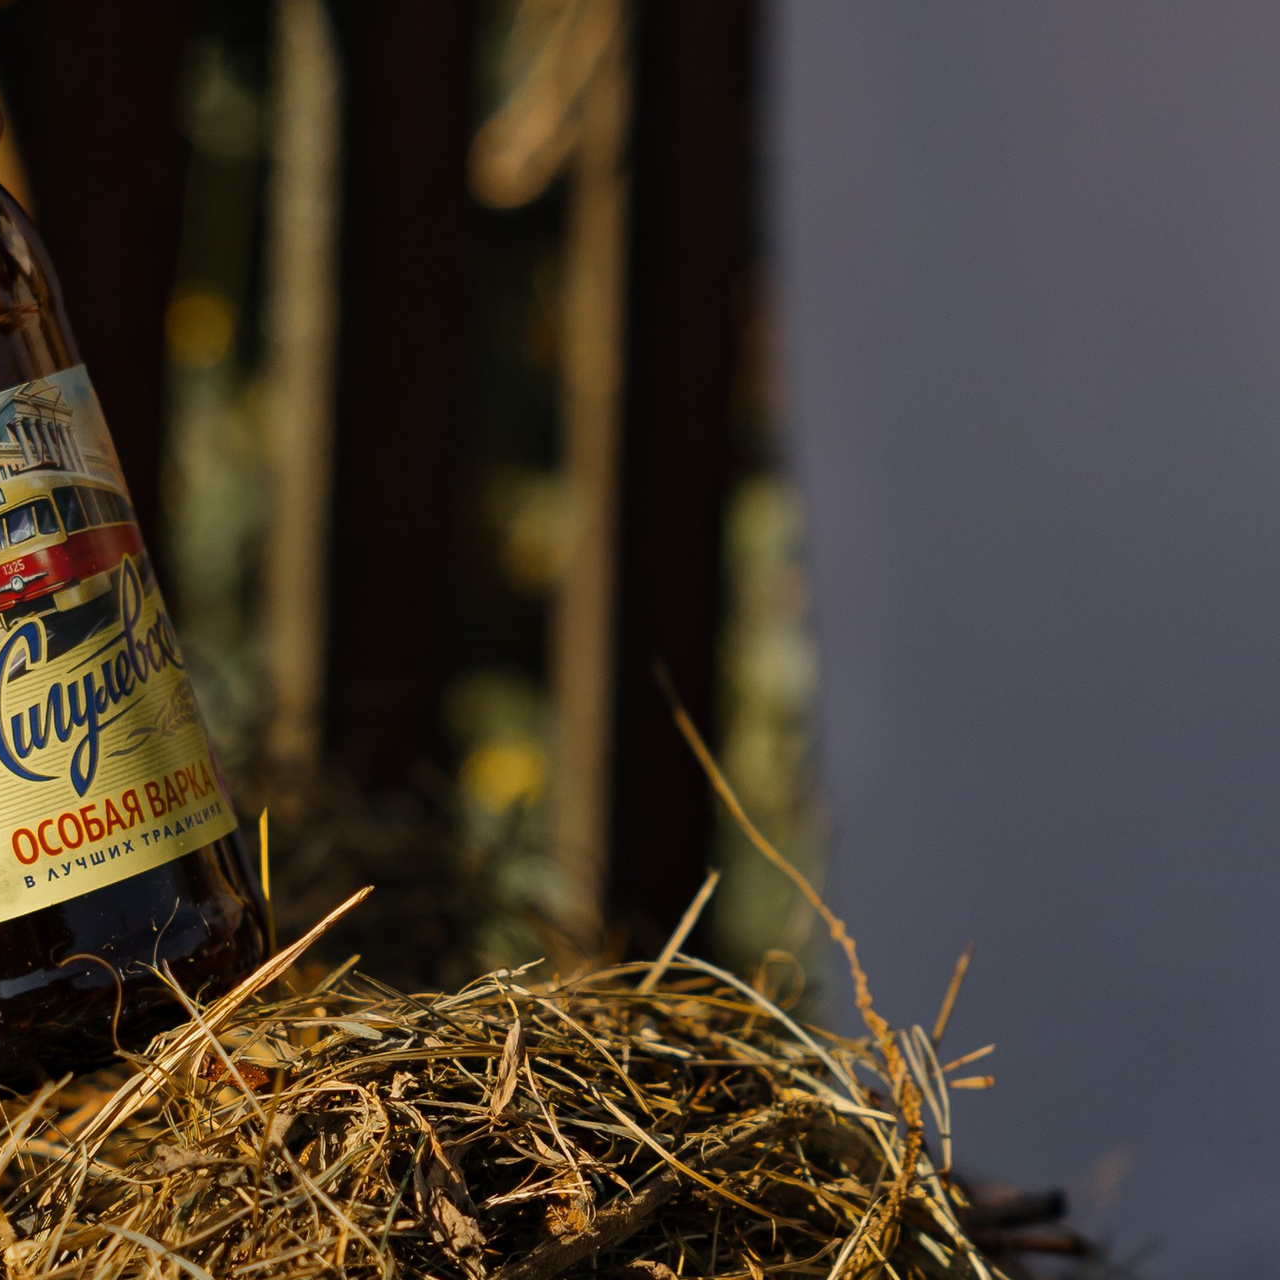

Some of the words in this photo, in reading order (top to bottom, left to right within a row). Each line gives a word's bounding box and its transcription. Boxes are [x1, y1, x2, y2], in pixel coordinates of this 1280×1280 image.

[2, 559, 26, 576] 1325
[11, 788, 146, 865] ОСОБАЯ
[143, 760, 216, 819] ВАРКА
[23, 874, 37, 889] В
[47, 839, 136, 882] ЛУЧШИХ
[141, 801, 223, 846] ТРАДИЦИЯХ
